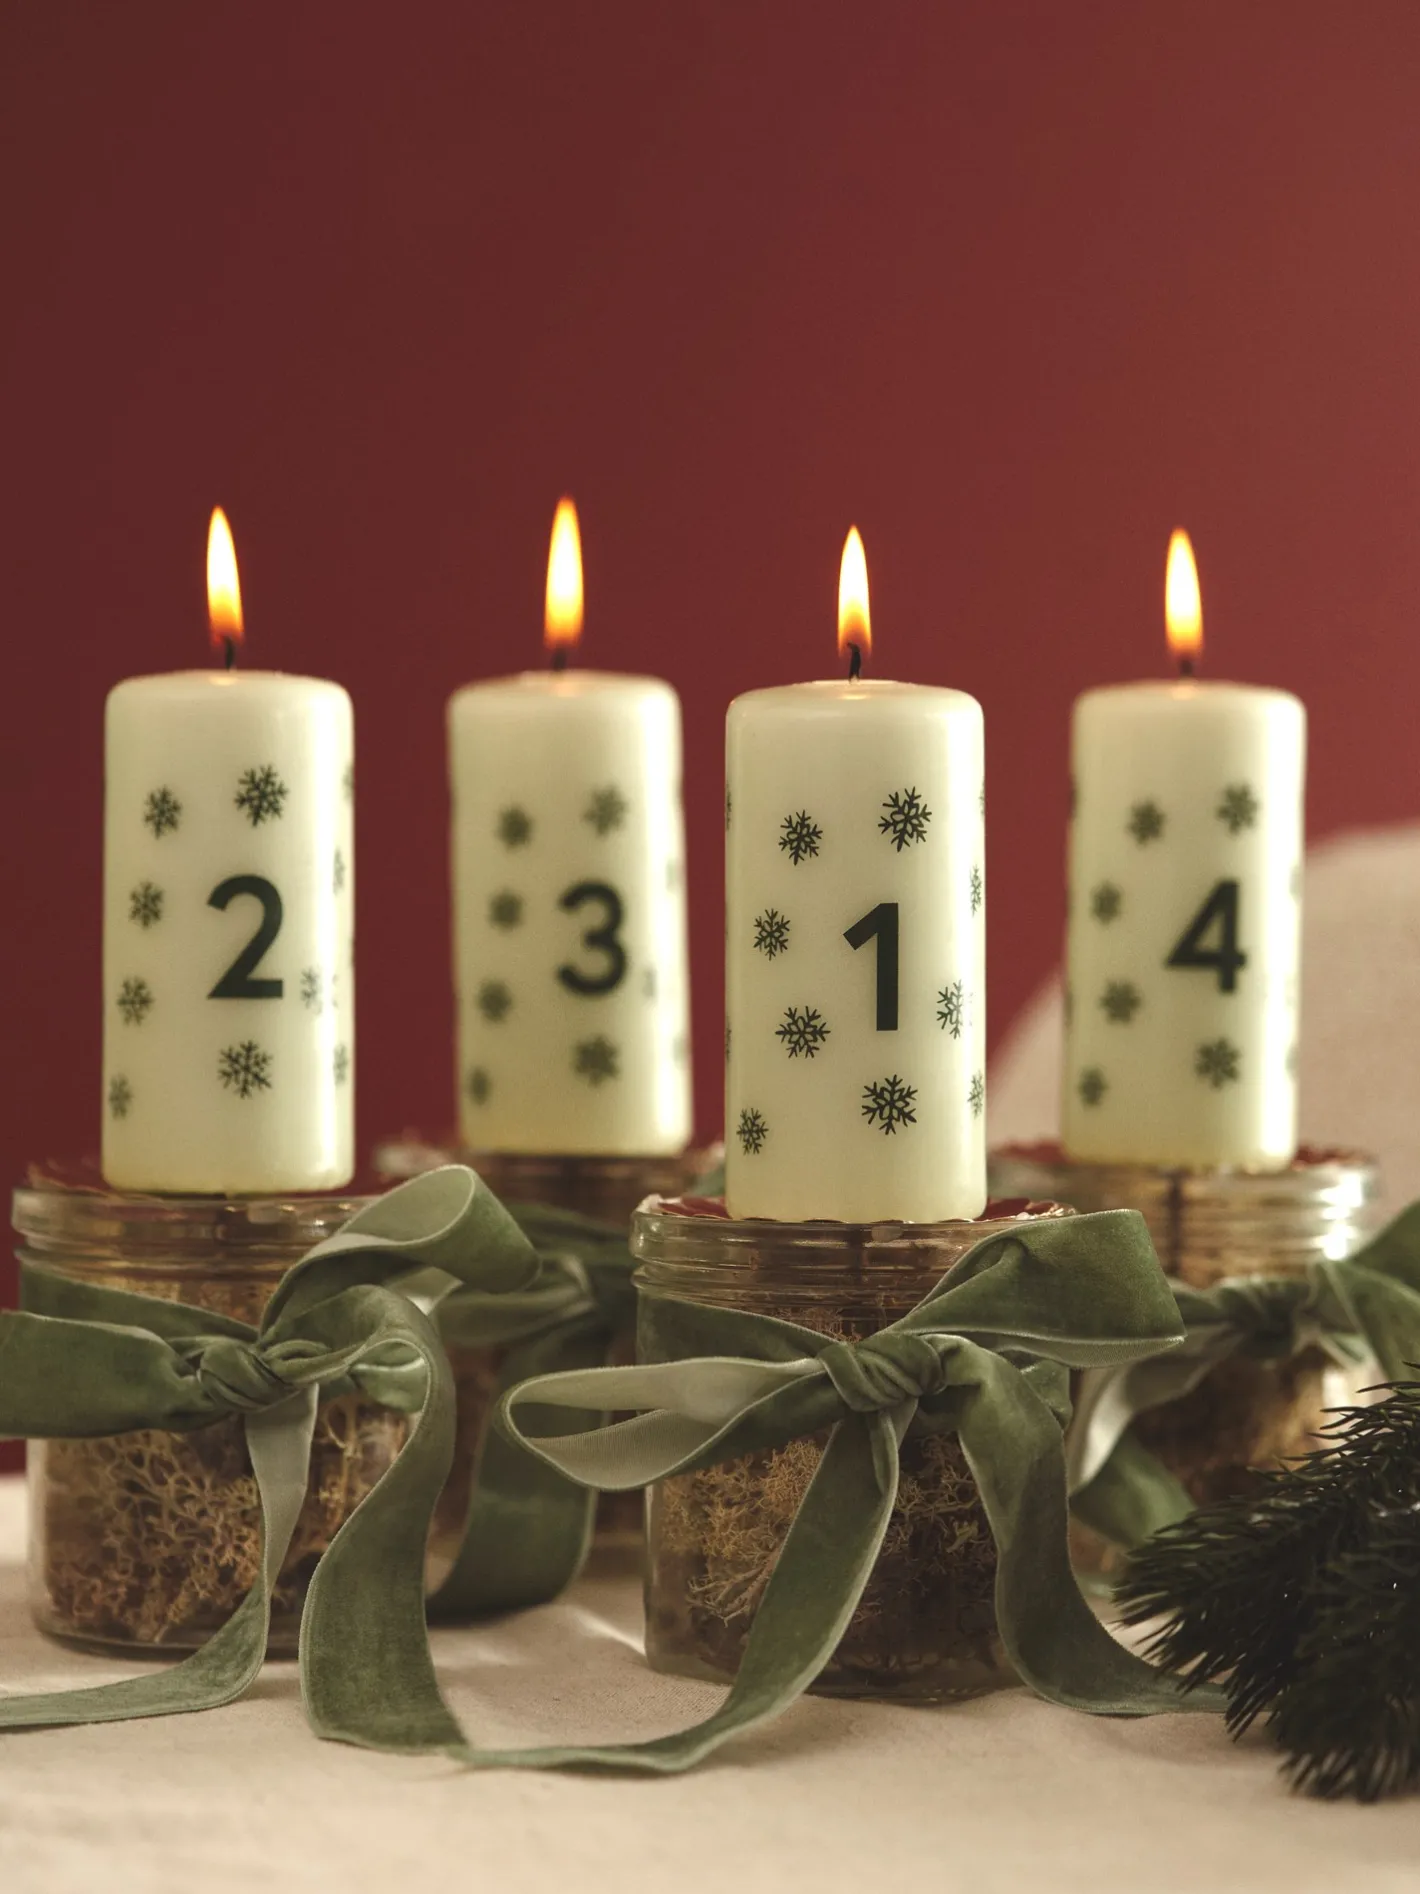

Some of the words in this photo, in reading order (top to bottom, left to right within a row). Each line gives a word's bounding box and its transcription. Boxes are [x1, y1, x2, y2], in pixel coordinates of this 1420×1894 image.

[206, 875, 283, 998] 2
[556, 880, 628, 995] 3
[843, 902, 899, 1032] 1
[1165, 879, 1247, 993] 4
